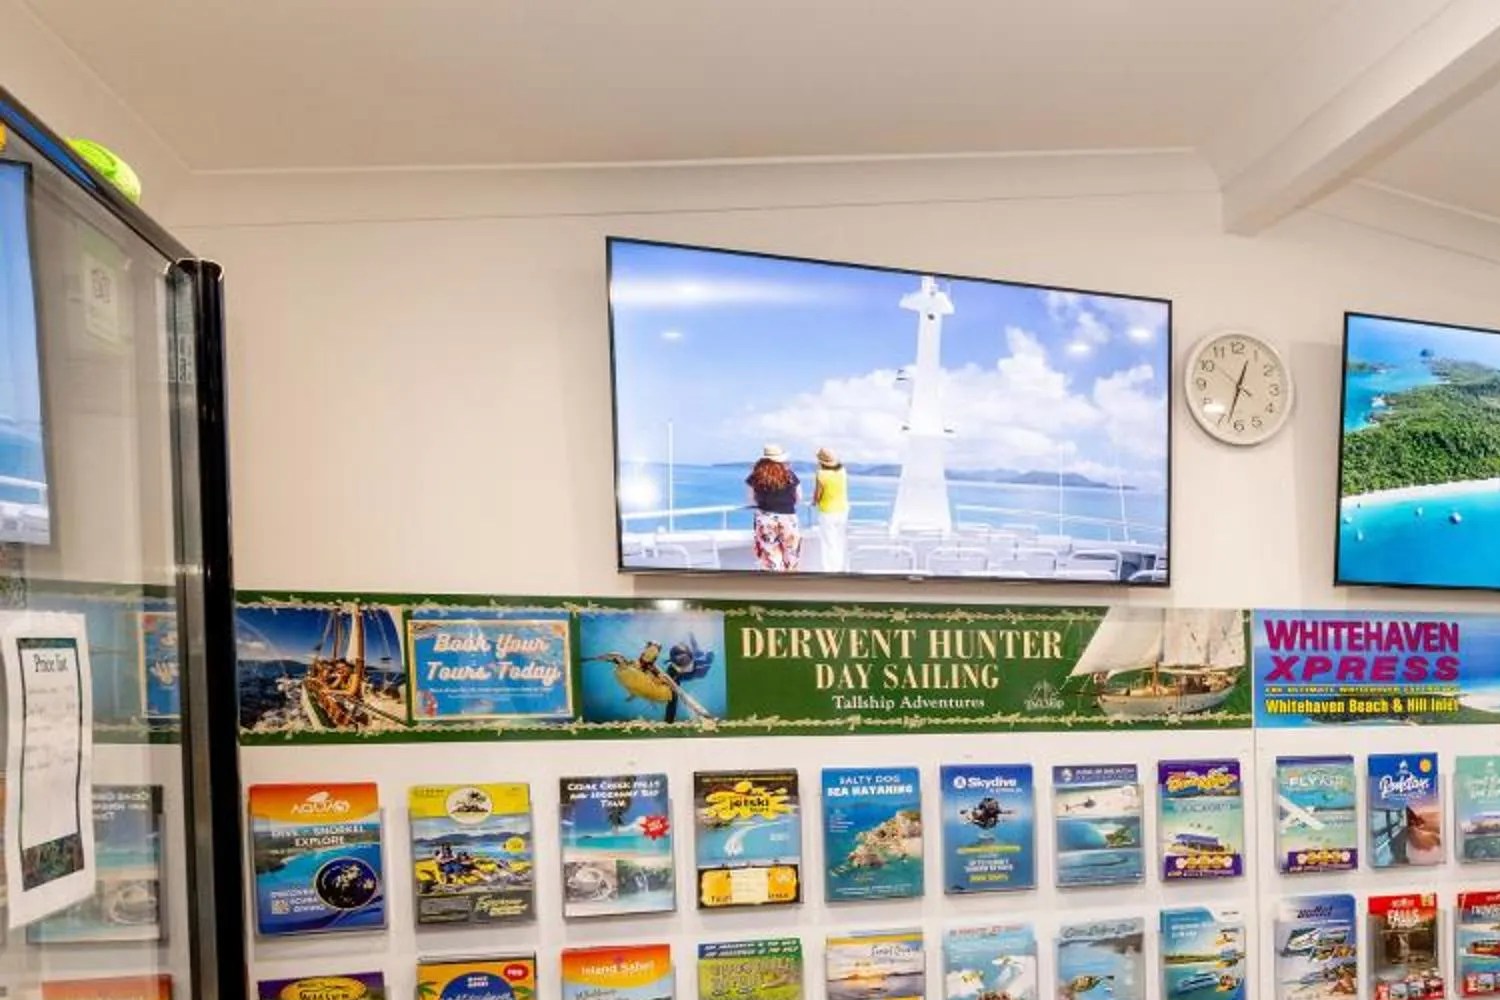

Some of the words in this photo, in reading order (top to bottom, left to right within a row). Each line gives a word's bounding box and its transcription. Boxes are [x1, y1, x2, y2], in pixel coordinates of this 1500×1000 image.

[434, 629, 491, 655] Book
[741, 627, 916, 659] DERWENT
[929, 629, 1063, 659] HUNTER
[1264, 620, 1459, 652] WHITEHAVEN
[427, 662, 491, 680] Tours
[495, 662, 561, 686] Today
[815, 664, 871, 689] DAY
[883, 663, 1000, 689] SAILING
[1264, 656, 1460, 681] XPRESS
[832, 696, 895, 710] Tallship
[900, 696, 985, 709] Adventures
[1265, 699, 1345, 713] Whitehaven
[1349, 699, 1389, 713] Beach
[1392, 697, 1404, 712] &
[1407, 697, 1427, 711] Hill
[1431, 697, 1460, 712] Inlet
[839, 776, 872, 785] SALTY
[875, 775, 900, 784] DOG
[967, 776, 1017, 789] Skydive
[827, 788, 849, 797] SEA
[851, 785, 914, 796] KAYAKING
[312, 824, 366, 837] SNORKEL
[294, 836, 345, 847] EXPLORE
